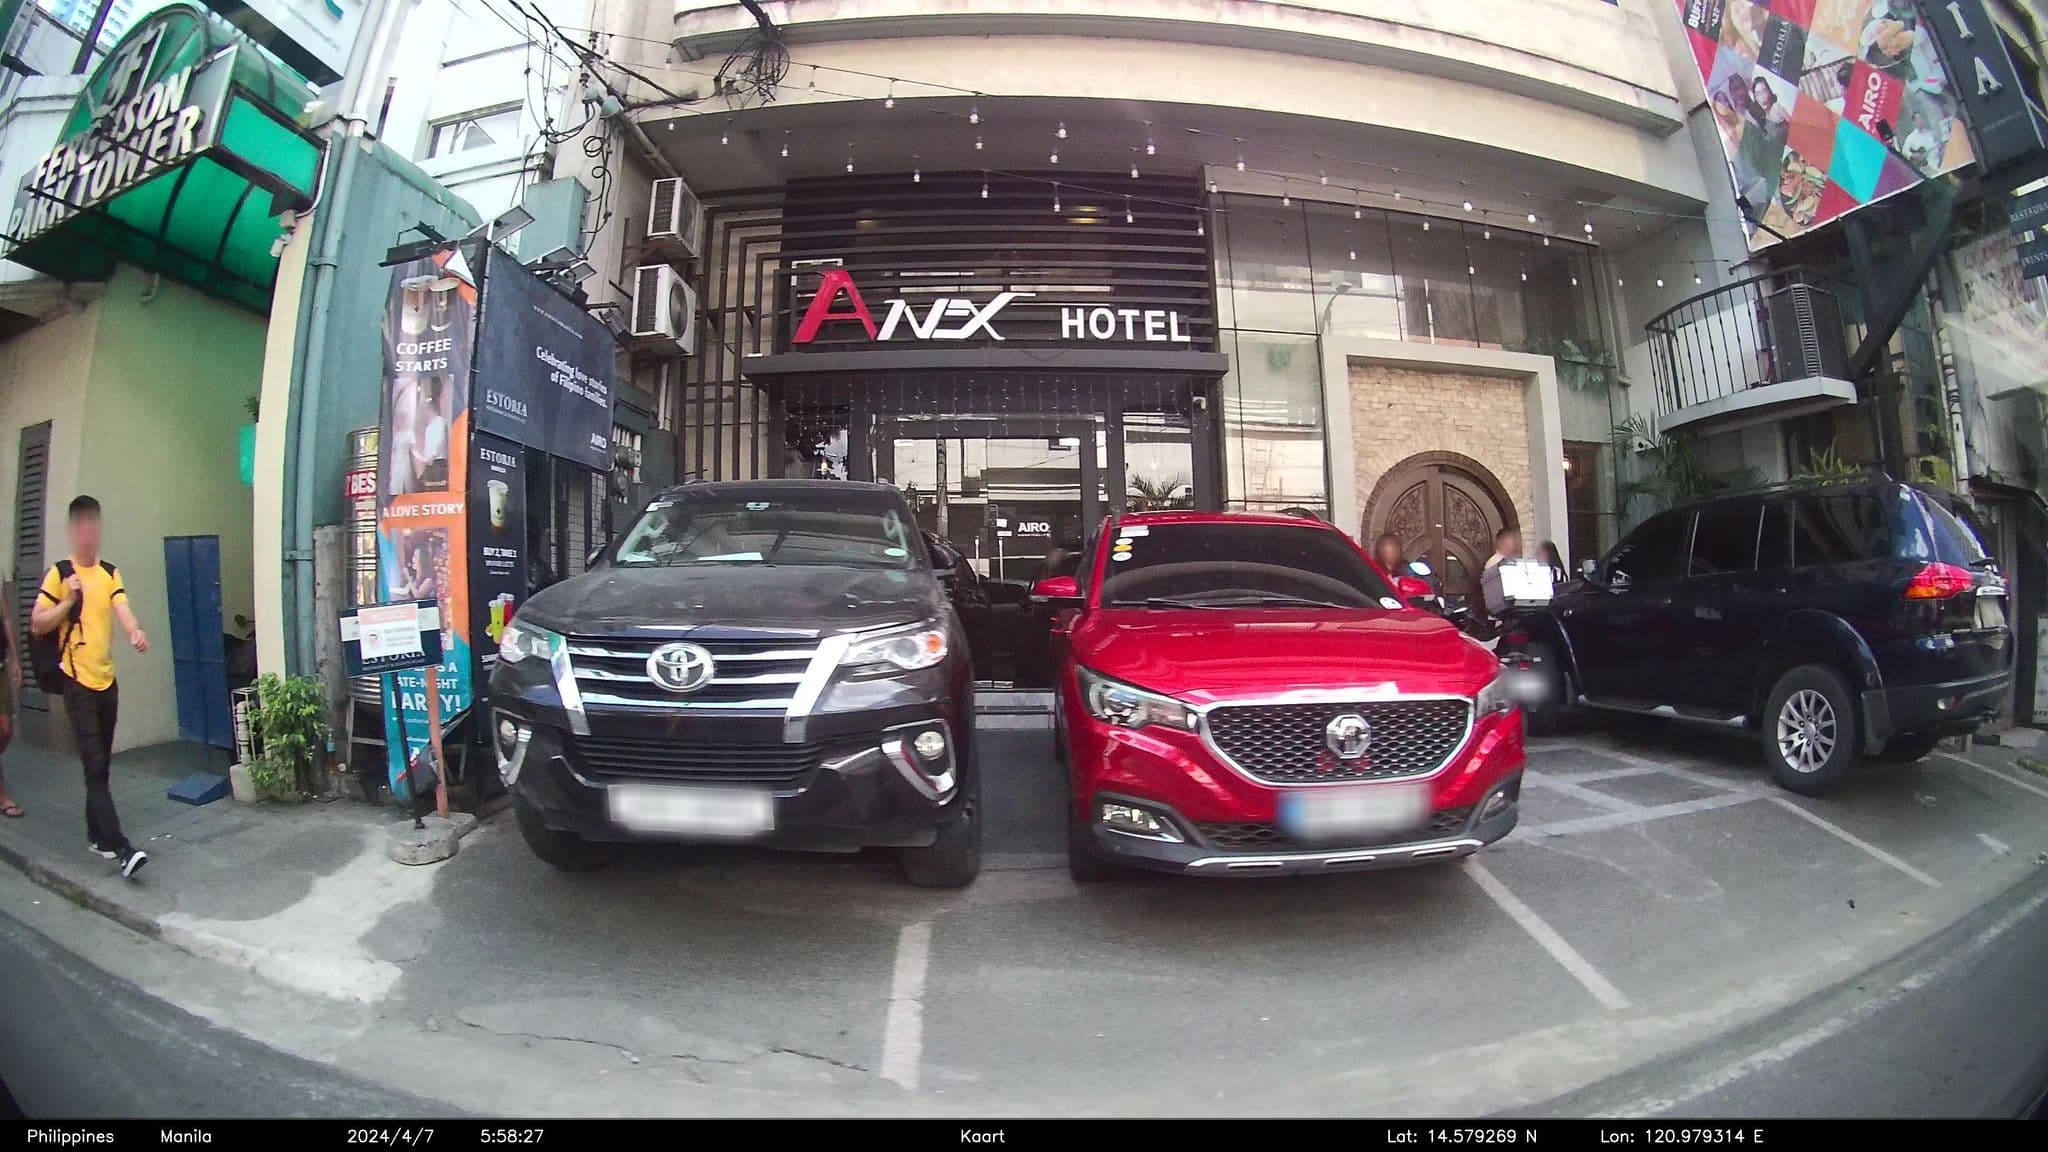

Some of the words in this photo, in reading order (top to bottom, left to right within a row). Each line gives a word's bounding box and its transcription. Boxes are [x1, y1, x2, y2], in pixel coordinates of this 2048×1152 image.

[1858, 72, 1882, 131] AIRO
[75, 105, 201, 206] TOWER
[1061, 307, 1191, 342] HOTEL
[396, 338, 452, 355] COFFEE
[395, 357, 448, 372] STARTS
[536, 346, 575, 380] Celebrating
[486, 389, 528, 417] ESTORIA
[480, 447, 517, 468] ESTORIA
[382, 507, 390, 518] A
[391, 505, 419, 518] LOVE
[421, 503, 465, 516] STORY
[1018, 522, 1050, 533] AIRO
[448, 662, 458, 673] A
[397, 676, 458, 689] ATE-NGHT
[391, 691, 462, 713] ARY!
